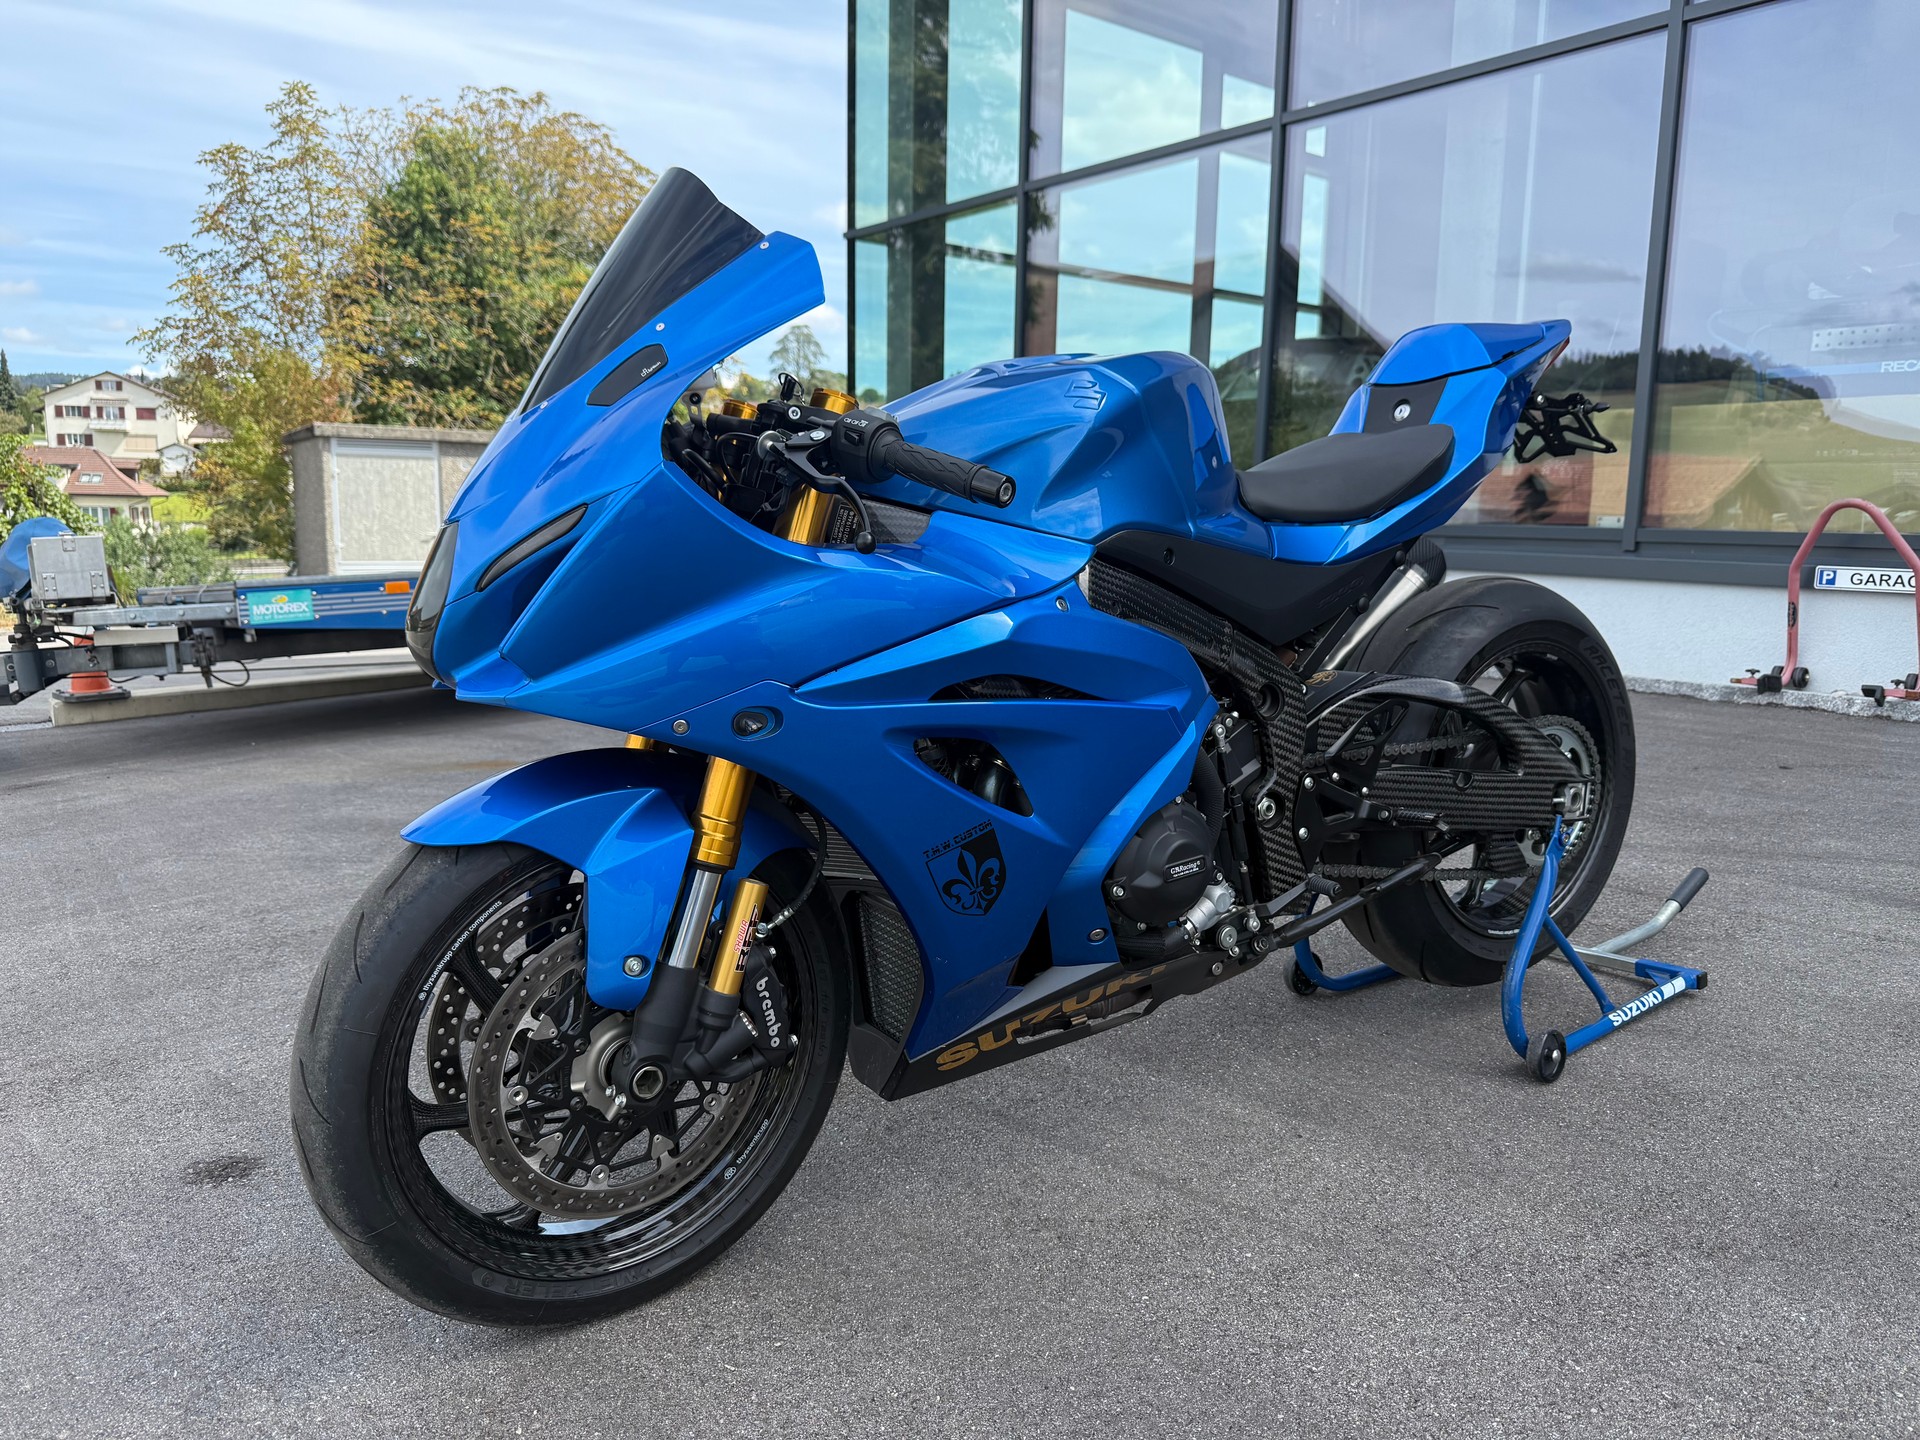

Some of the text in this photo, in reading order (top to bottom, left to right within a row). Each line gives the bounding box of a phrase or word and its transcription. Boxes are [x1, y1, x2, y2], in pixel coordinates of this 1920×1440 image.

[1821, 570, 1834, 585] P
[252, 601, 310, 616] MOTOREX
[953, 819, 993, 844] CUSTOM
[422, 900, 503, 991] thyssenkrupp carbon components
[734, 919, 749, 953] SHOWA
[756, 976, 782, 1048] brembo
[1608, 990, 1663, 1027] SUZUKI
[736, 1118, 770, 1165] thyssenkrupp
